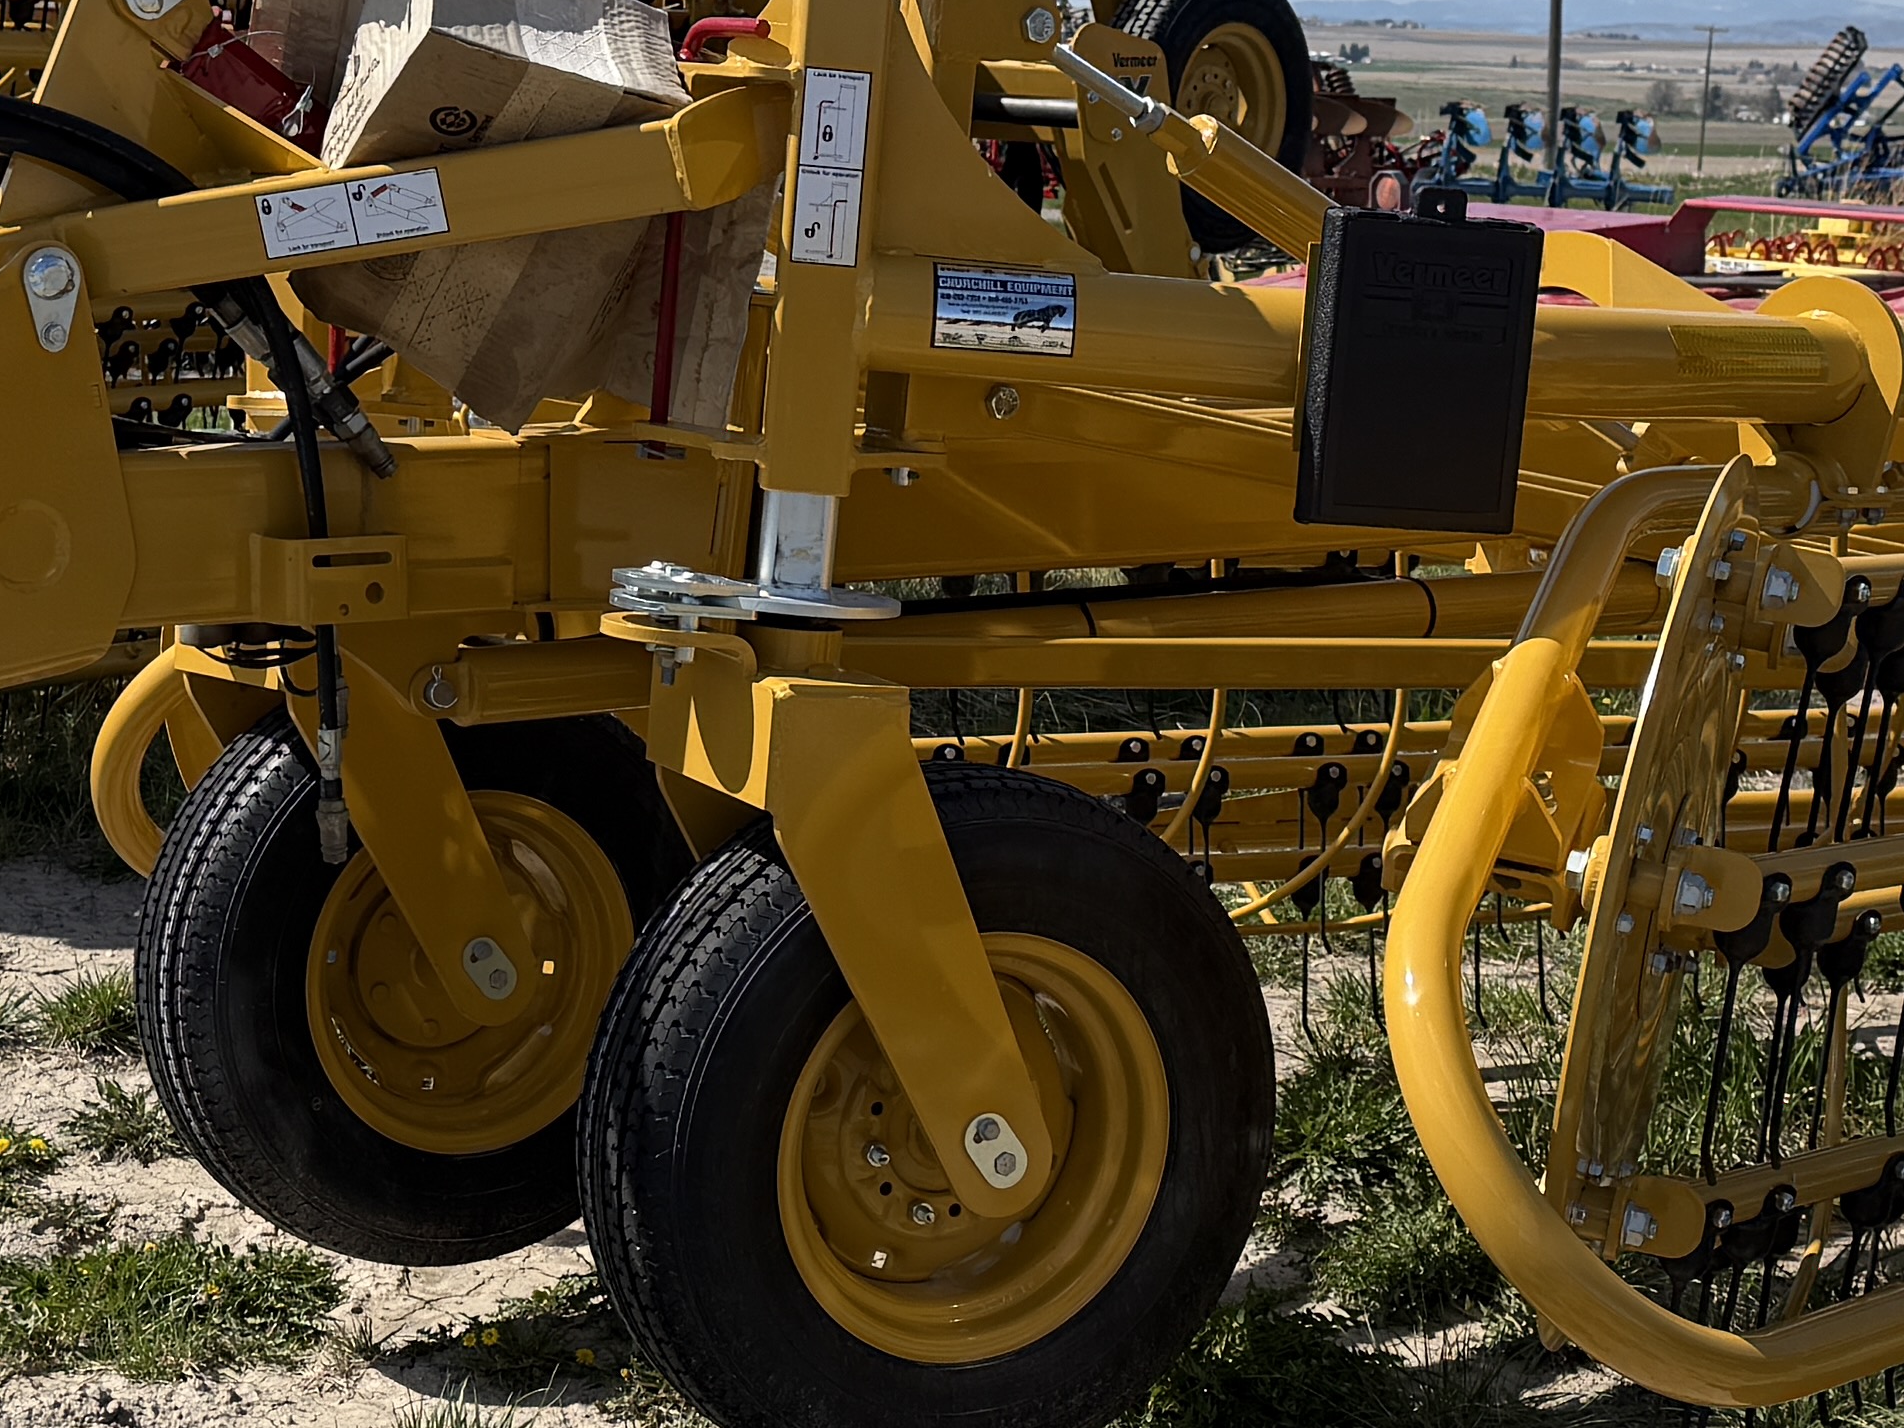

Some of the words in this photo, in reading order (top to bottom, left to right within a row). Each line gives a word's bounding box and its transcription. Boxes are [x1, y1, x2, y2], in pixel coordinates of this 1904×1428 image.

[1112, 53, 1158, 68] Vermeer
[1372, 251, 1506, 291] Vermeer
[939, 277, 1005, 291] CHURCHILL
[1007, 281, 1074, 295] EQUIPMENT
